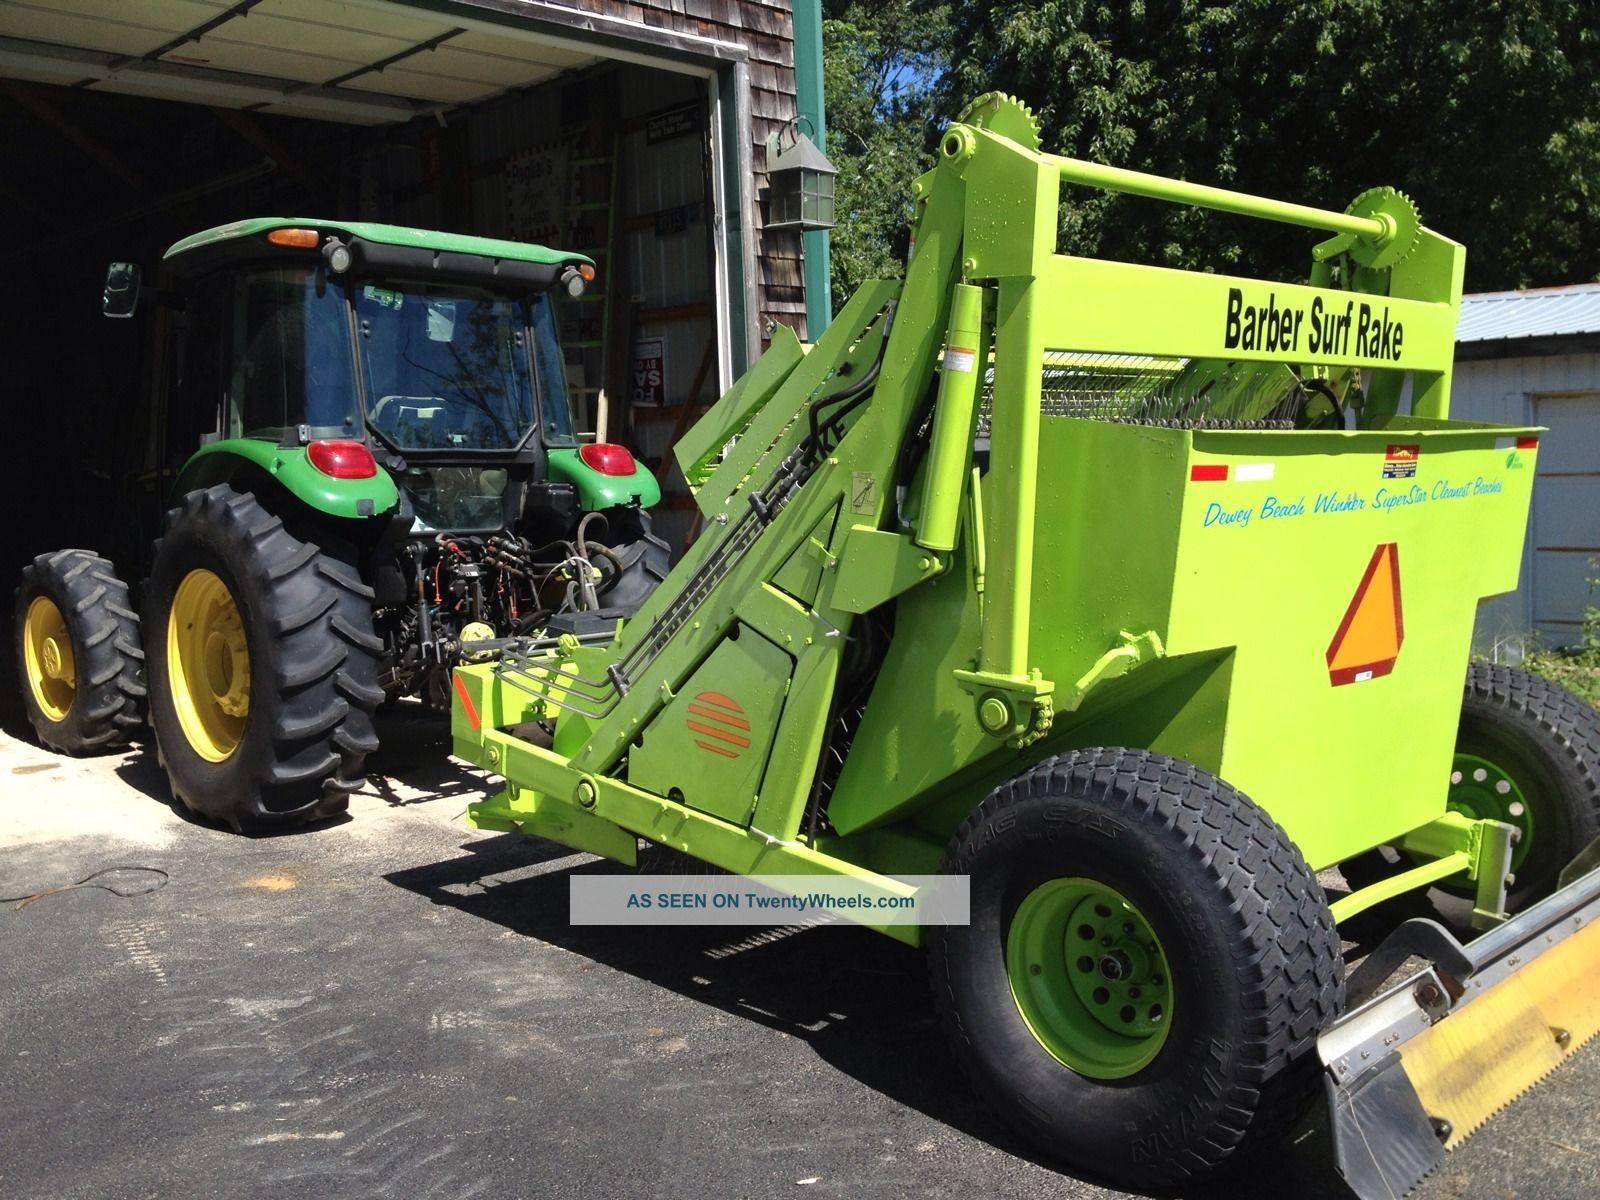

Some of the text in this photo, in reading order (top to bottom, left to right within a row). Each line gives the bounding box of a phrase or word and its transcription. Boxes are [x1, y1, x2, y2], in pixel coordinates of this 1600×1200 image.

[1224, 287, 1403, 361] Barber Surf Rake
[633, 387, 655, 401] FO
[634, 369, 661, 387] SA
[1203, 502, 1253, 528] Dewey
[1260, 496, 1305, 519] Beach
[1372, 484, 1427, 514] SuperStar
[1431, 480, 1472, 501] Cleanest
